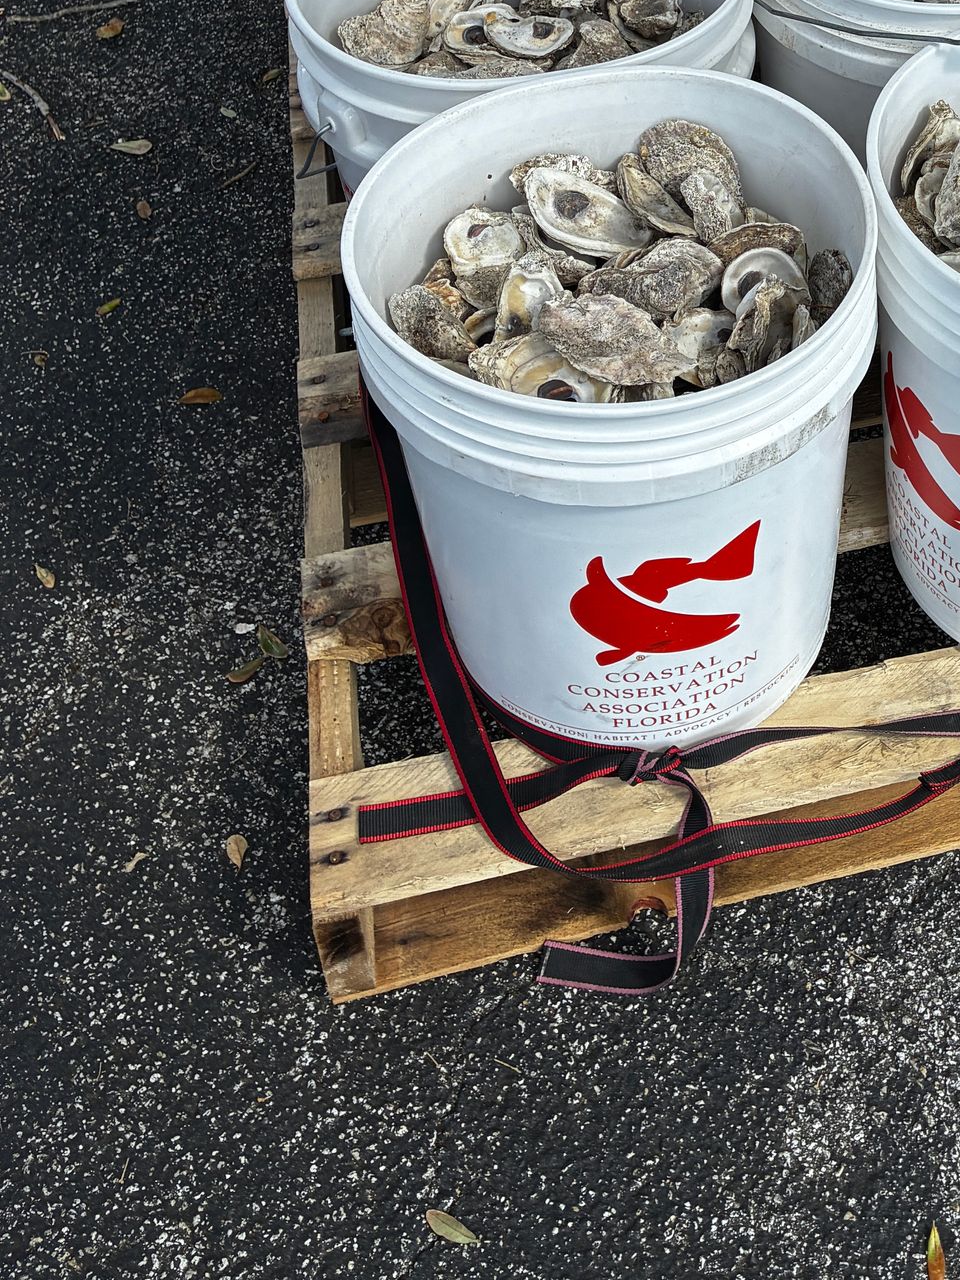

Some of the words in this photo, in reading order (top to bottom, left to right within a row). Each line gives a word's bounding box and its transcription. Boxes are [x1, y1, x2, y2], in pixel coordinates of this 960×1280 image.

[892, 470, 952, 550] COASTAL
[915, 571, 959, 614] ADVOCACY
[567, 649, 759, 700] CONSERVATION
[604, 655, 722, 684] COASTAL
[582, 672, 746, 715] ASSOCIATION
[593, 733, 649, 742] HABITAT
[664, 709, 732, 738] ADVOCACY
[742, 656, 801, 708] RESTOCKING
[612, 701, 718, 729] FLORIDA
